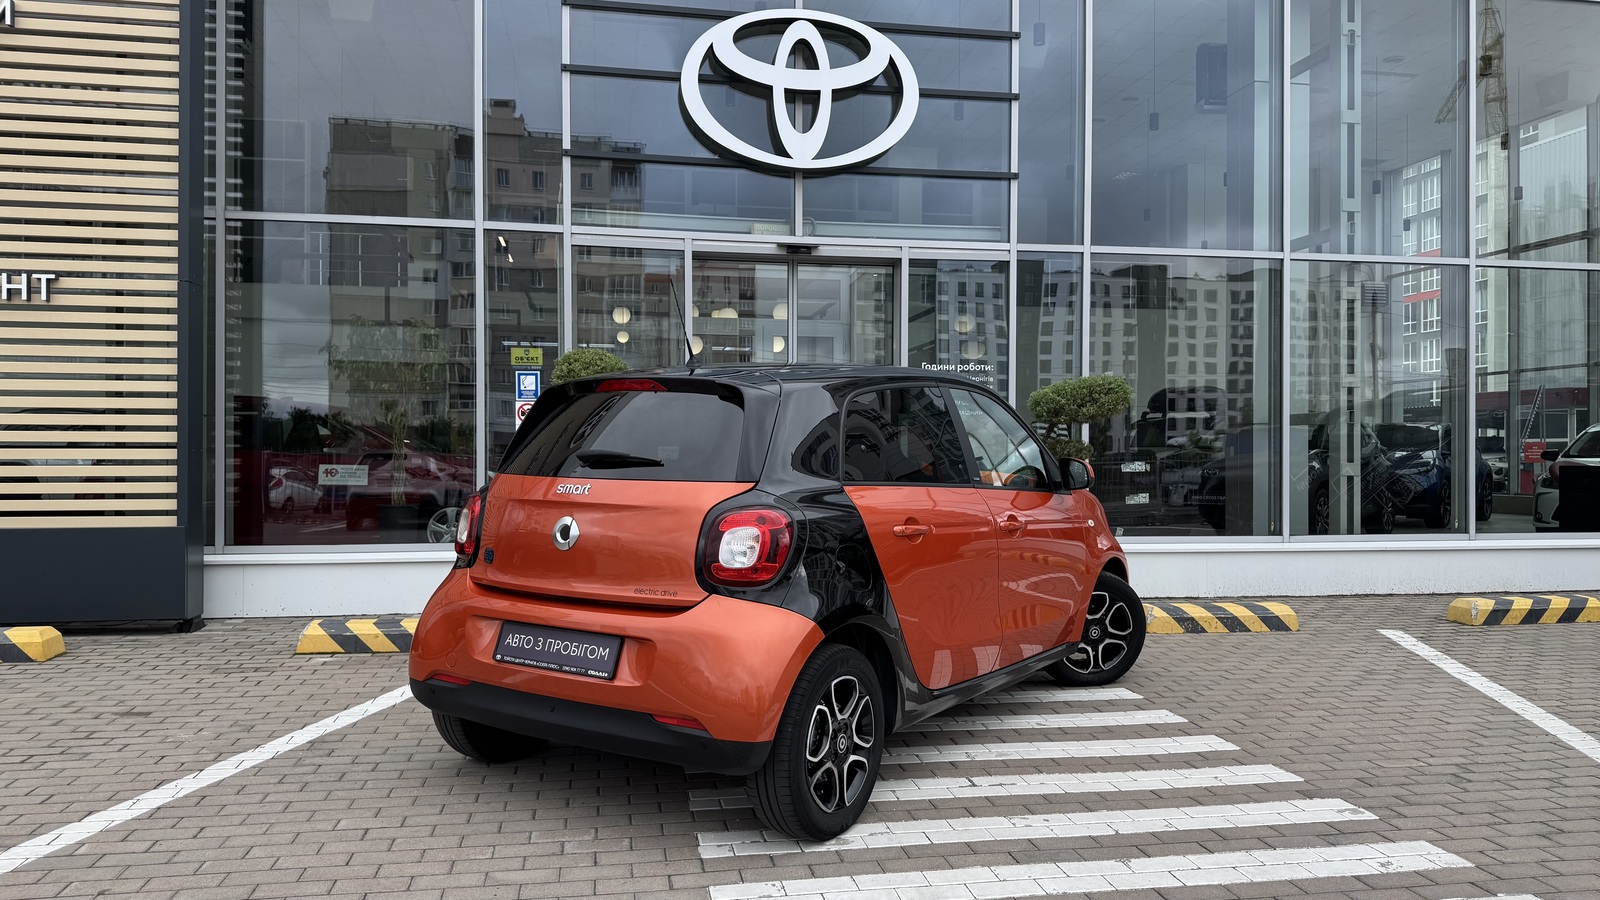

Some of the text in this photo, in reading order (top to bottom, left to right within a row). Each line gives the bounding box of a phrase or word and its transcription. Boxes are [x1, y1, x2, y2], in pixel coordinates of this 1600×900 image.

[921, 362, 994, 372] Години роботи:
[556, 483, 592, 495] smart
[633, 587, 678, 597] electric drive
[504, 633, 534, 649] АВТО
[544, 638, 610, 661] ПРОБІГОМ
